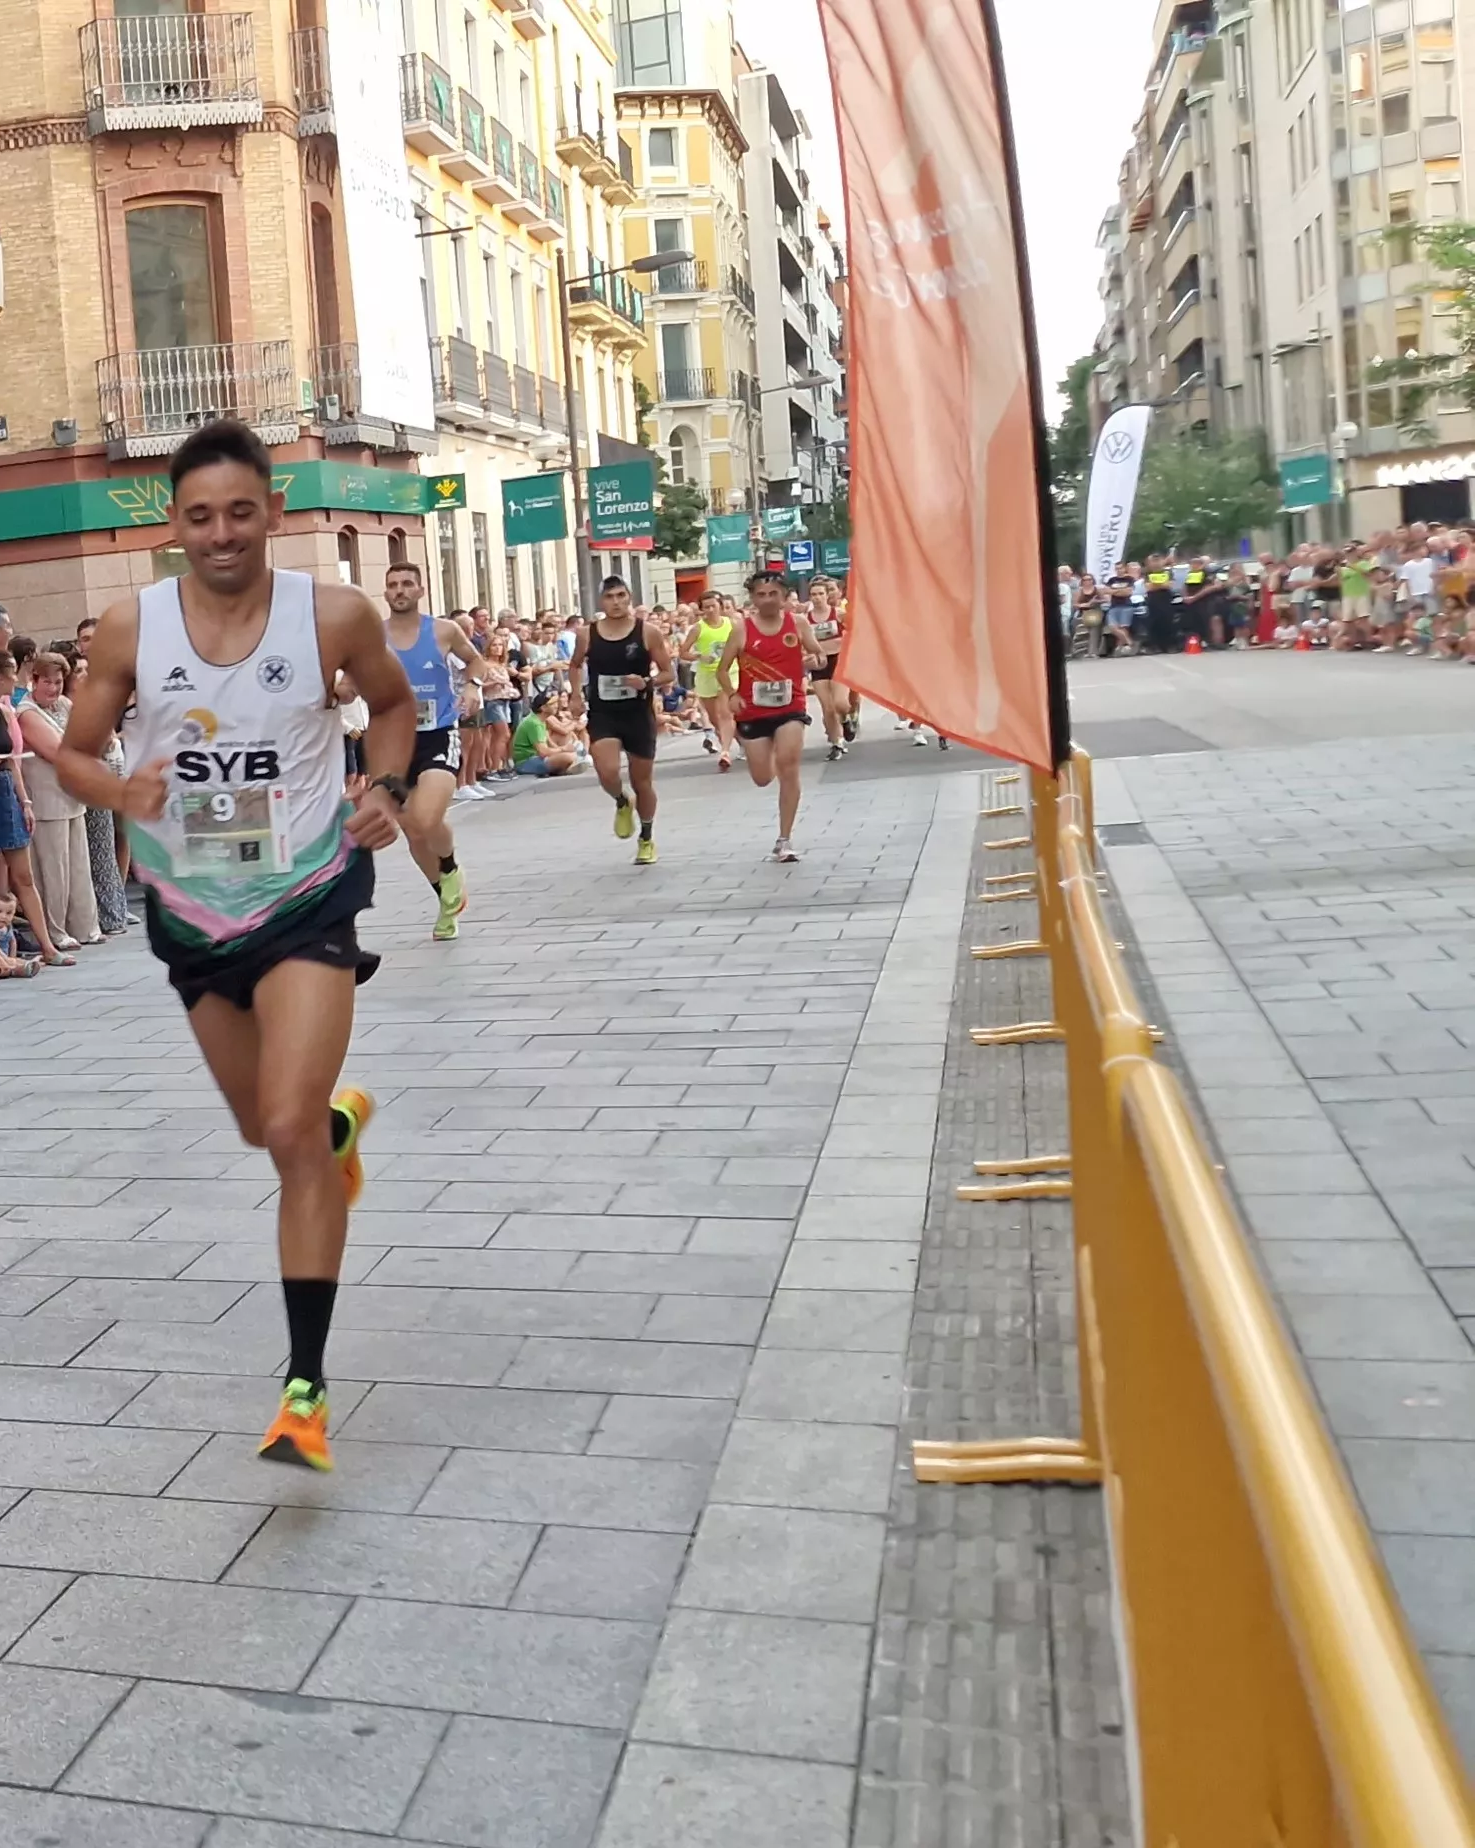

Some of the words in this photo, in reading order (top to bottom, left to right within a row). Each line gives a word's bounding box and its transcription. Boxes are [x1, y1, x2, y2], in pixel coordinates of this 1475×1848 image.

[593, 479, 620, 490] vive
[595, 490, 622, 503] San
[596, 501, 649, 515] Lorenzo
[766, 681, 780, 691] 14
[175, 750, 280, 783] SYB
[211, 792, 236, 823] 9
